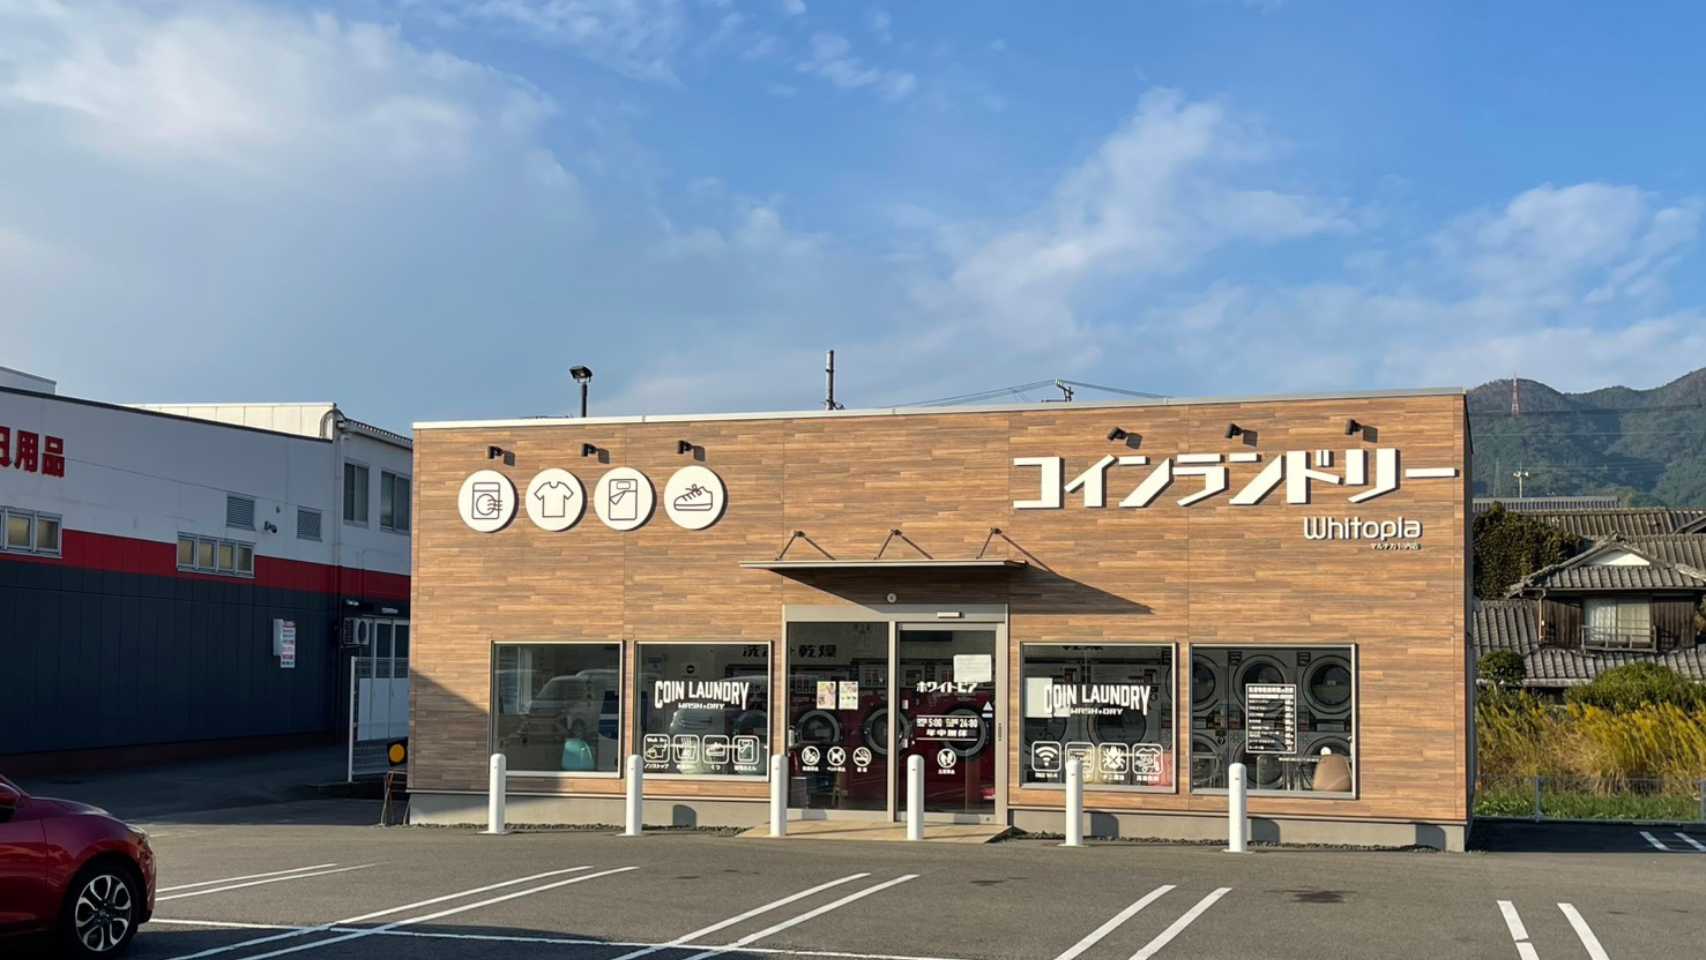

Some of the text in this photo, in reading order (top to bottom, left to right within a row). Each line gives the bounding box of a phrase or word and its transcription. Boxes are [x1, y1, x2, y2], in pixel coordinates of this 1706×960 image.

[1013, 448, 1456, 508] コインランドリー
[654, 680, 749, 710] COIN LAUNDRY
[1081, 684, 1151, 716] LAUNDRY
